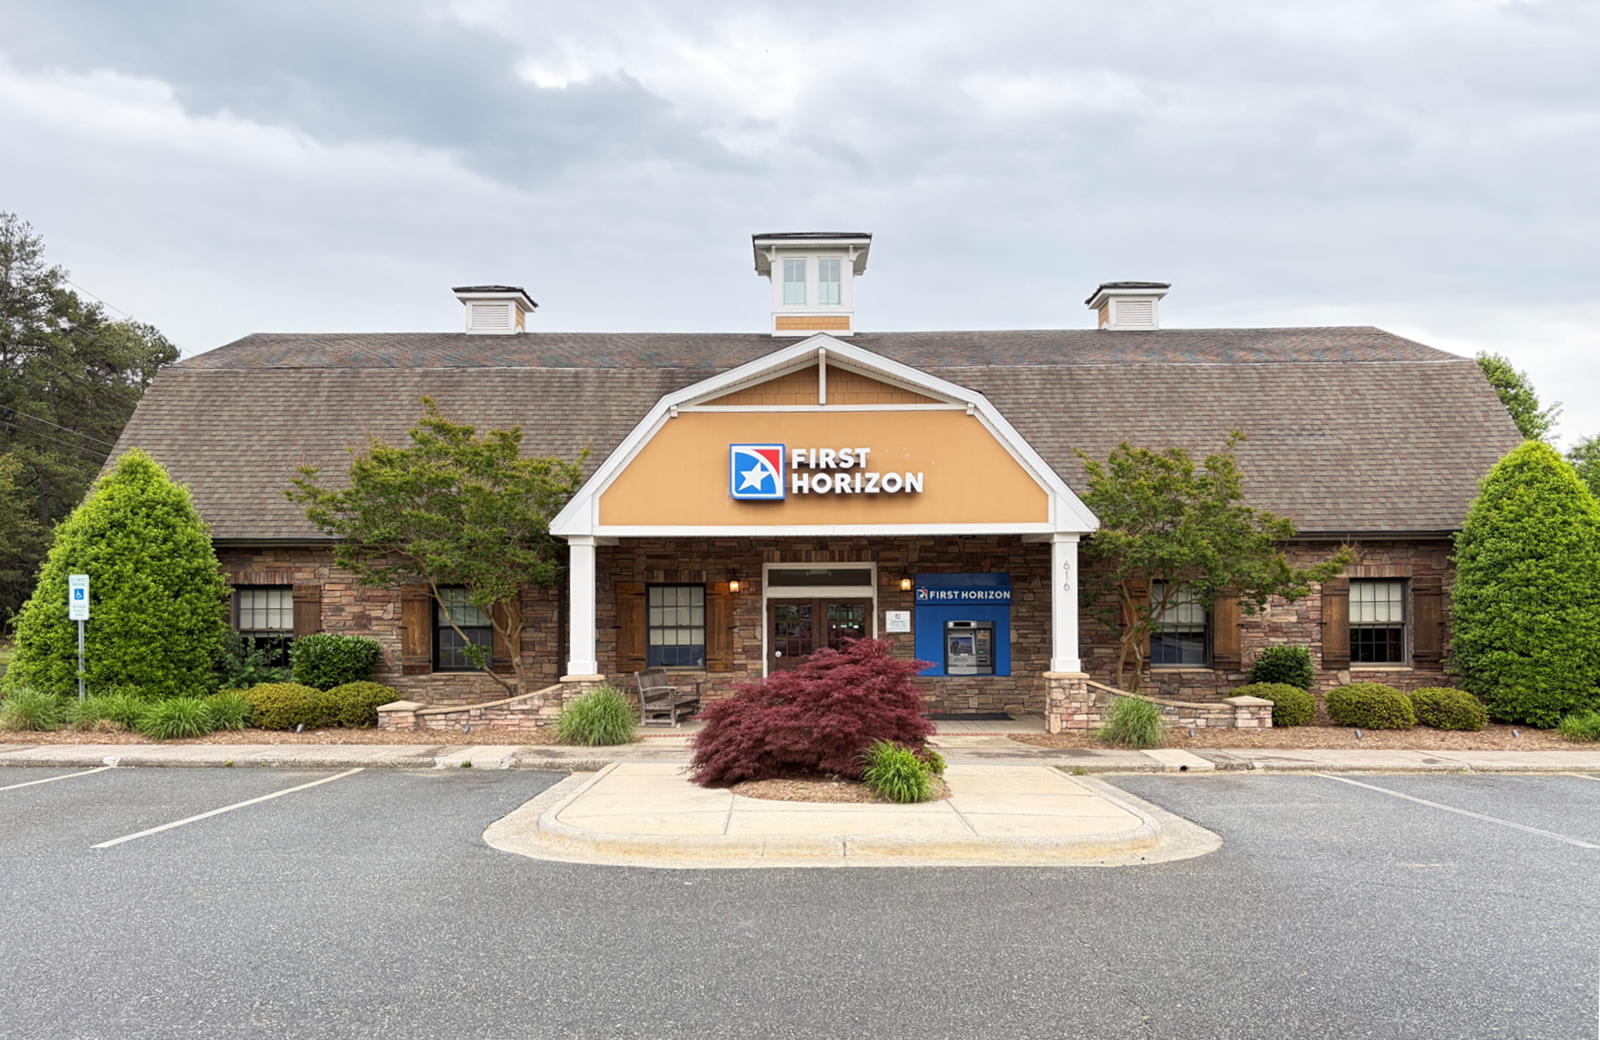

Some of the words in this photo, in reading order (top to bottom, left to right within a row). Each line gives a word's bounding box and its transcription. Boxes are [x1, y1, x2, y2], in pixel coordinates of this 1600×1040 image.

[791, 447, 871, 469] FIRST
[791, 472, 924, 494] HORIZON
[1063, 560, 1071, 591] 616
[930, 590, 960, 599] FIRST
[961, 590, 1011, 599] HORIZON
